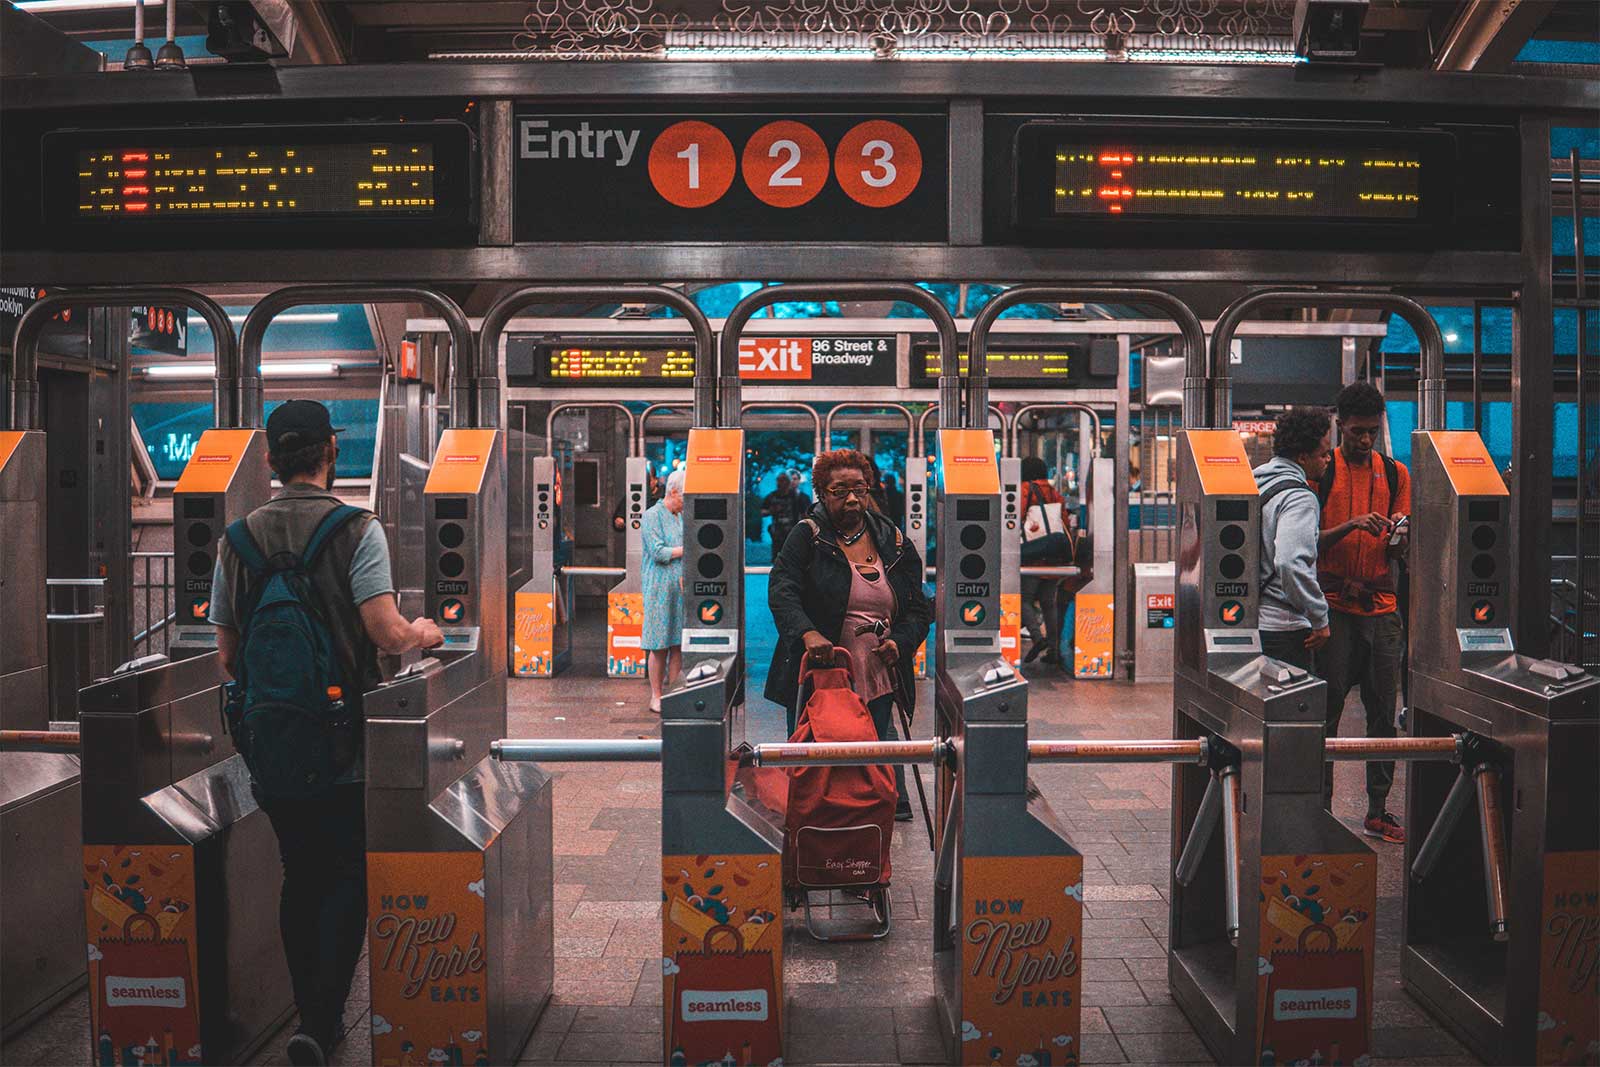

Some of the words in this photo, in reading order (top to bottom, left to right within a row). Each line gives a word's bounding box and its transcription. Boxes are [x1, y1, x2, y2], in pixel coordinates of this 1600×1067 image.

[520, 120, 641, 167] Entry
[677, 143, 700, 188] 1
[768, 140, 803, 186] 2
[860, 140, 897, 188] 3
[812, 340, 830, 352] 96
[834, 340, 873, 352] Street
[877, 340, 887, 352] &
[738, 340, 803, 371] Exit
[812, 352, 873, 366] Broadway
[437, 581, 467, 594] Entry
[695, 582, 726, 595] Entry
[957, 583, 988, 596] Entry
[1216, 583, 1247, 596] Entry
[1469, 583, 1497, 596] Entry
[1148, 595, 1172, 607] Exit
[381, 895, 430, 910] HOW
[976, 898, 1024, 915] HOW
[374, 912, 457, 970] New
[966, 918, 1052, 977] New
[400, 932, 486, 999] York
[992, 935, 1078, 1005] York
[111, 983, 181, 1001] seamless
[430, 986, 481, 1002] EATS
[1022, 991, 1073, 1008] EATS
[687, 998, 762, 1015] seamless
[1279, 997, 1351, 1013] seamless
